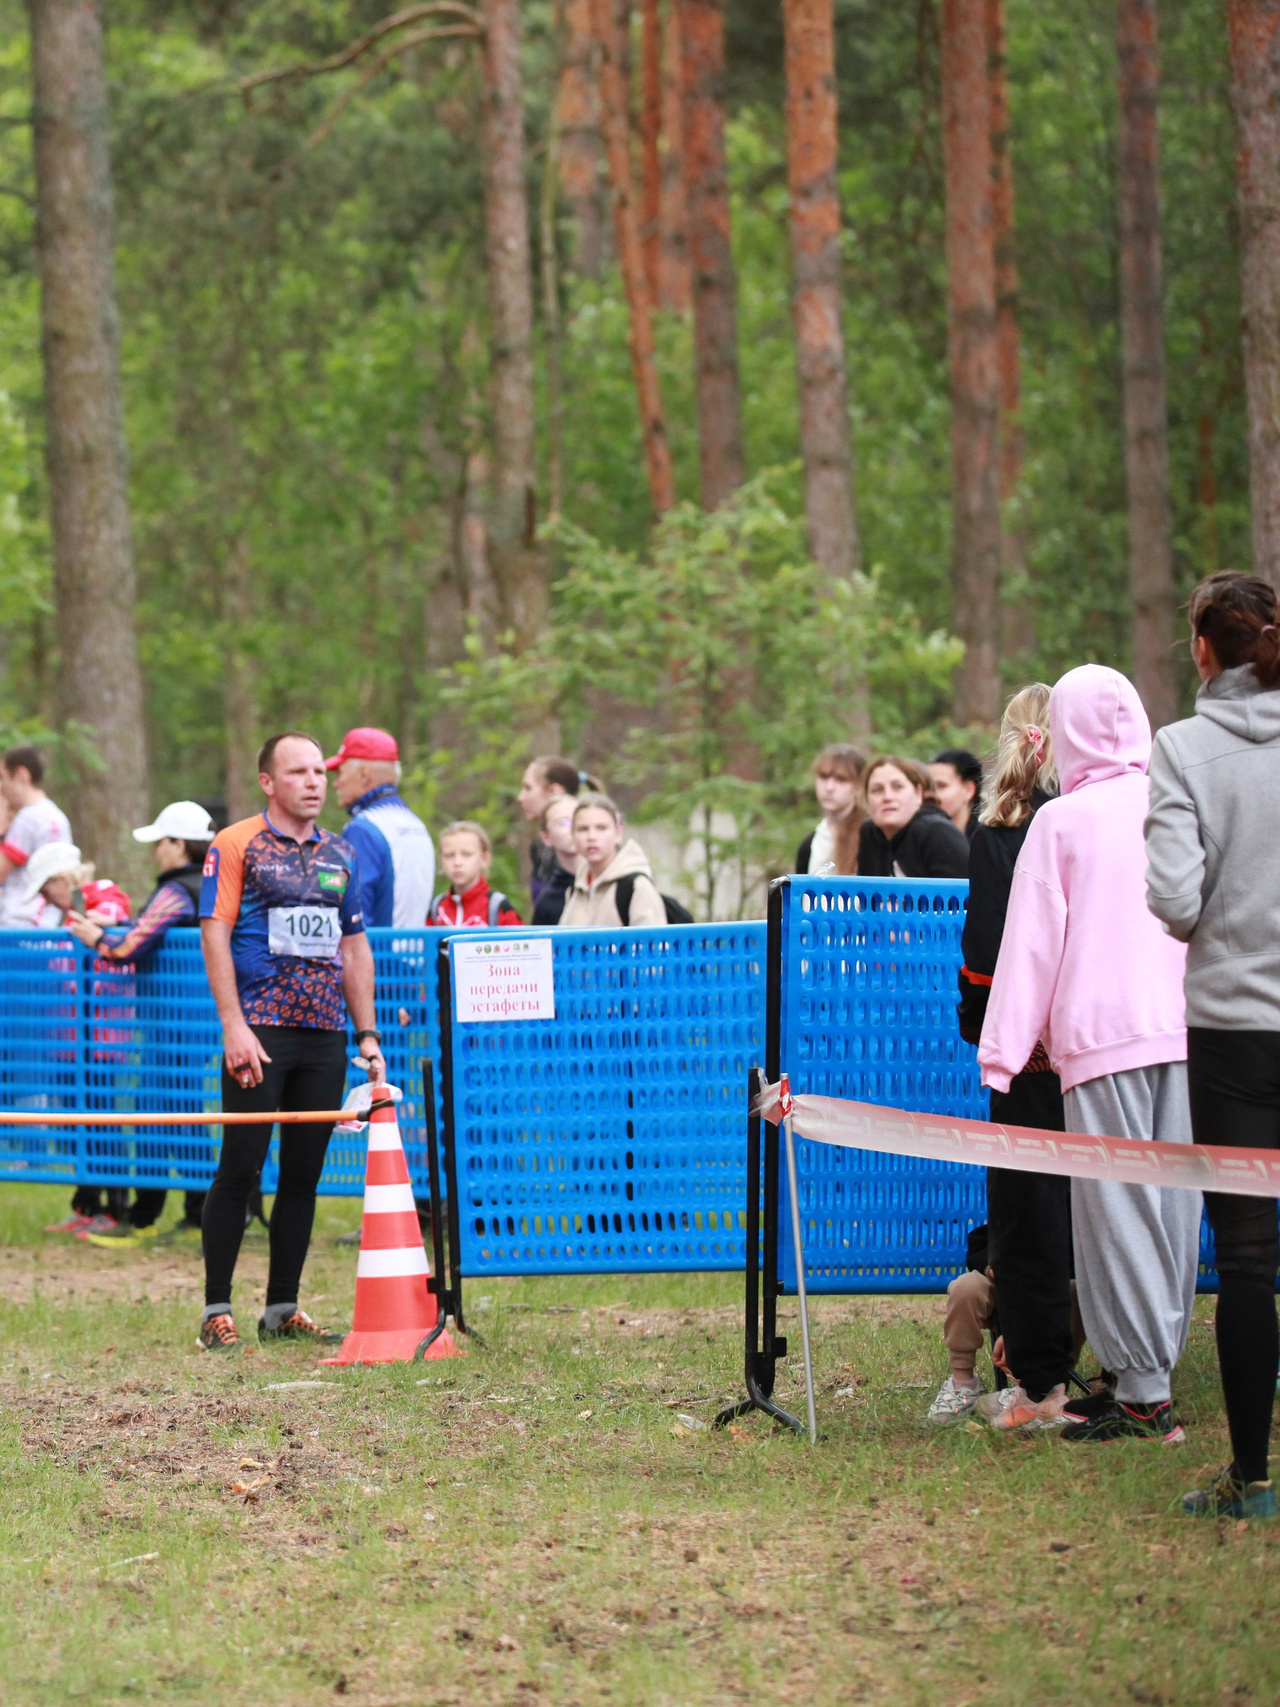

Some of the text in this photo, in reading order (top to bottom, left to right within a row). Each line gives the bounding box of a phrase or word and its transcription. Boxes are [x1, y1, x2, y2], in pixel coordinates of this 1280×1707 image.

[285, 914, 333, 938] 1021
[486, 963, 521, 977] Зона
[470, 983, 538, 998] передачи
[469, 998, 540, 1015] эстафеты
